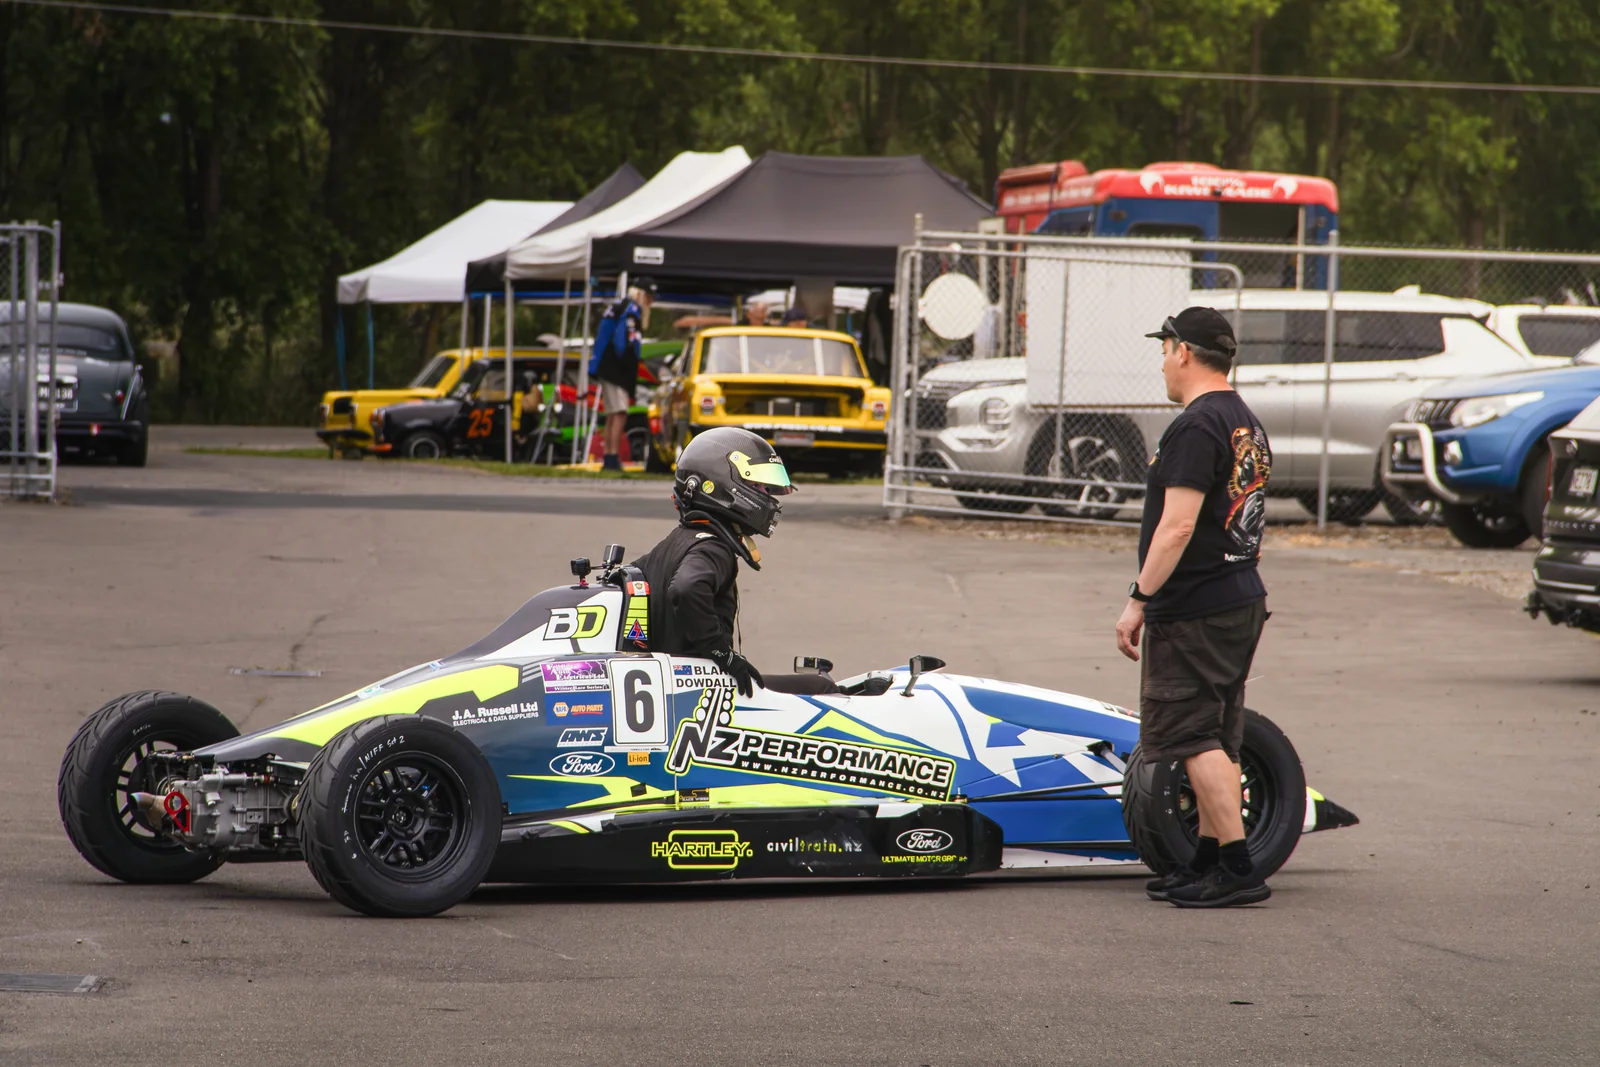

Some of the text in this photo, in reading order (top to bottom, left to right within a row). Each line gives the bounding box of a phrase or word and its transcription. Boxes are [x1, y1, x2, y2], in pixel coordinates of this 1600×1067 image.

[467, 407, 496, 438] 25
[543, 604, 607, 641] BD
[694, 665, 729, 676] BLAK
[676, 678, 736, 688] DOWDALL
[571, 704, 586, 713] AUTO
[586, 703, 604, 713] PARTS
[623, 669, 655, 733] 6
[477, 703, 518, 718] Russell
[520, 701, 539, 713] Ltd
[453, 717, 488, 727] ELECTRICAL
[493, 714, 508, 722] DATA
[508, 711, 539, 721] SUPPLIERS
[561, 754, 603, 774] Ford
[628, 755, 648, 763] Li-ion
[767, 837, 863, 852] civiltrain.nz
[907, 831, 942, 849] Ford
[882, 855, 915, 863] ULTIMATE
[916, 855, 940, 863] MOTOR
